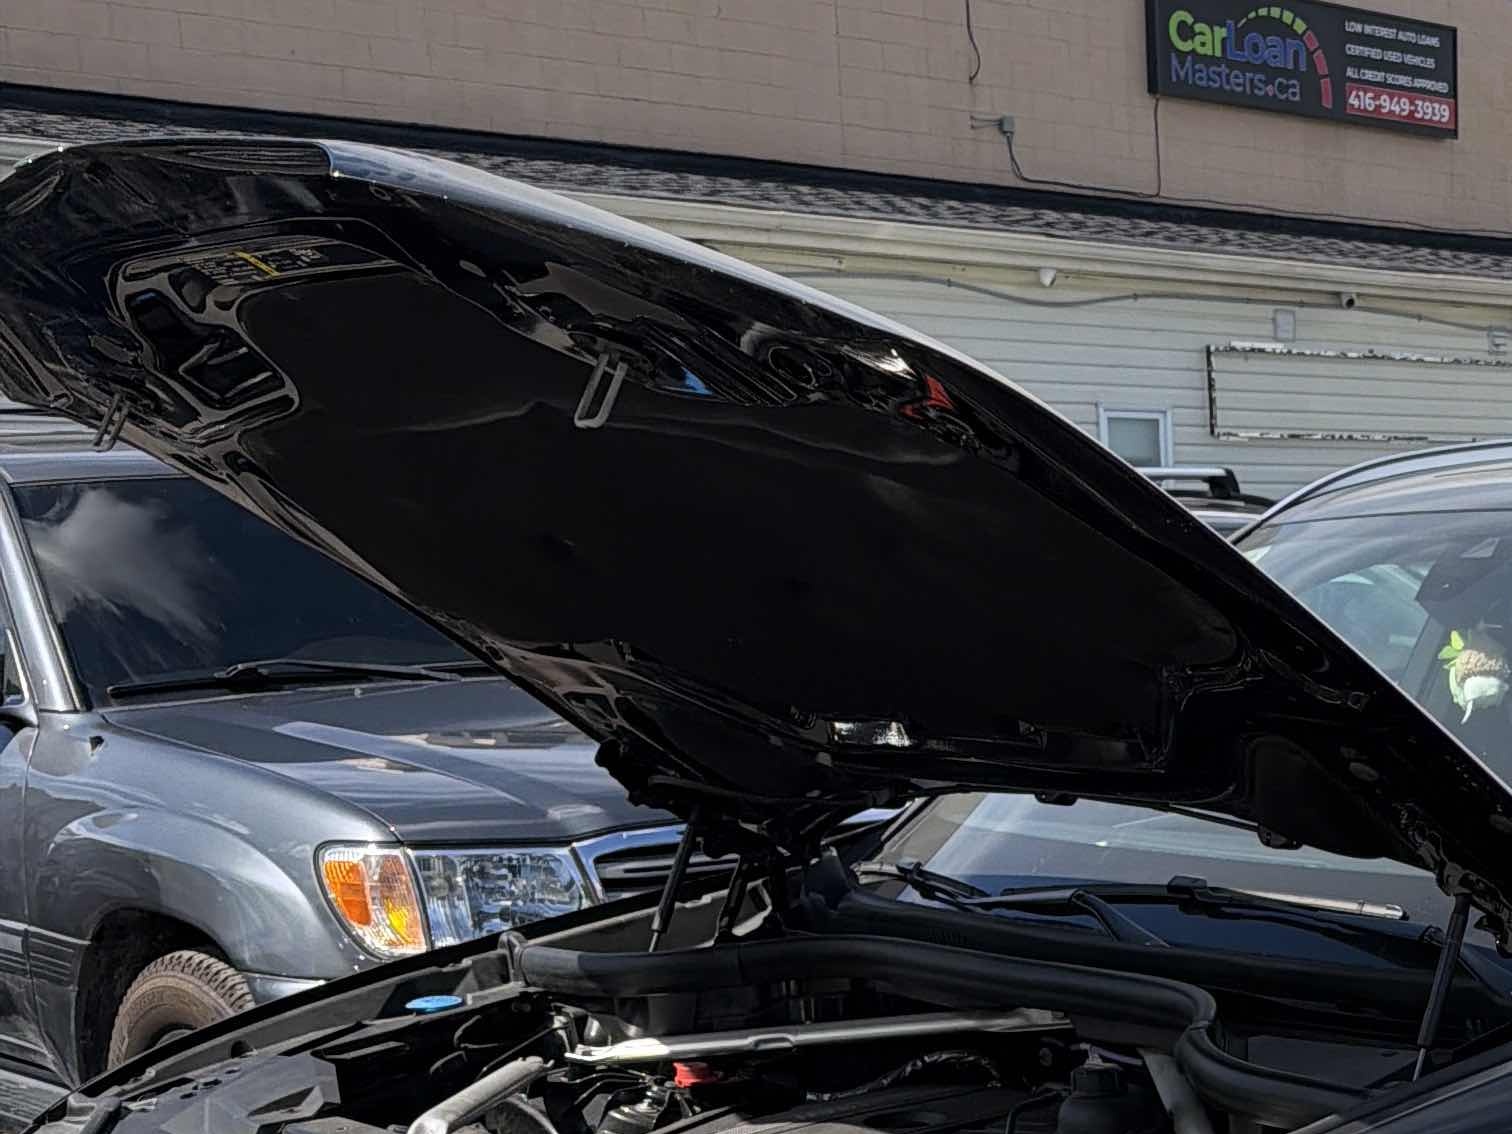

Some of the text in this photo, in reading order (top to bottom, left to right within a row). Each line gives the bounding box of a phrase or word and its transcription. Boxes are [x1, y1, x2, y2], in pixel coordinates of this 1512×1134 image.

[1345, 20, 1440, 48] LOW INTEREST AUTO LOANS
[1345, 44, 1436, 69] CERTIFIED USED VEHICLES
[1346, 66, 1449, 93] ALL CREDIT SCORES APPROVED
[1348, 90, 1450, 123] 416-949-3939
